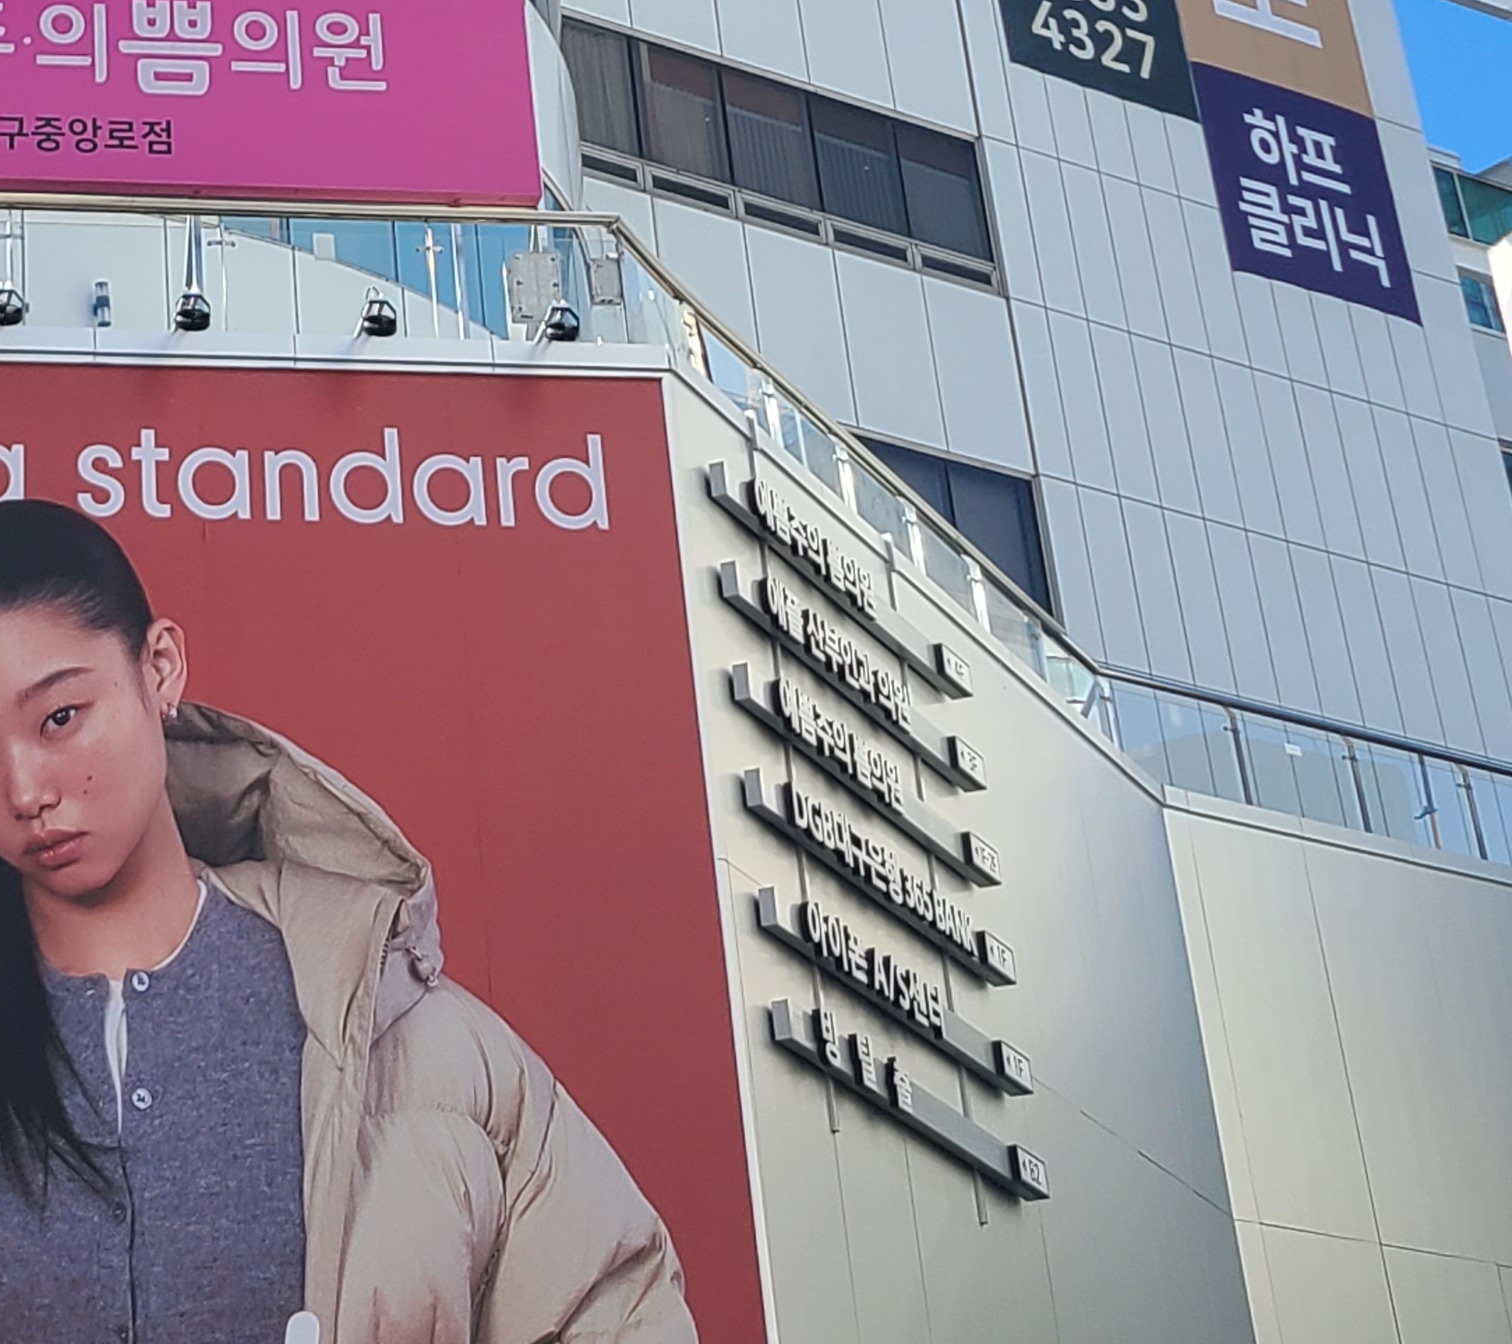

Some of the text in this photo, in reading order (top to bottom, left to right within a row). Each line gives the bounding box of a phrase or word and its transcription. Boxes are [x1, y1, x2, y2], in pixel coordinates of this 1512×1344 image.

[1030, 0, 1157, 81] 4327
[1242, 107, 1352, 196] 하프
[1237, 176, 1391, 289] 클리닉
[76, 427, 610, 532] standard
[807, 900, 869, 985] 아이폰
